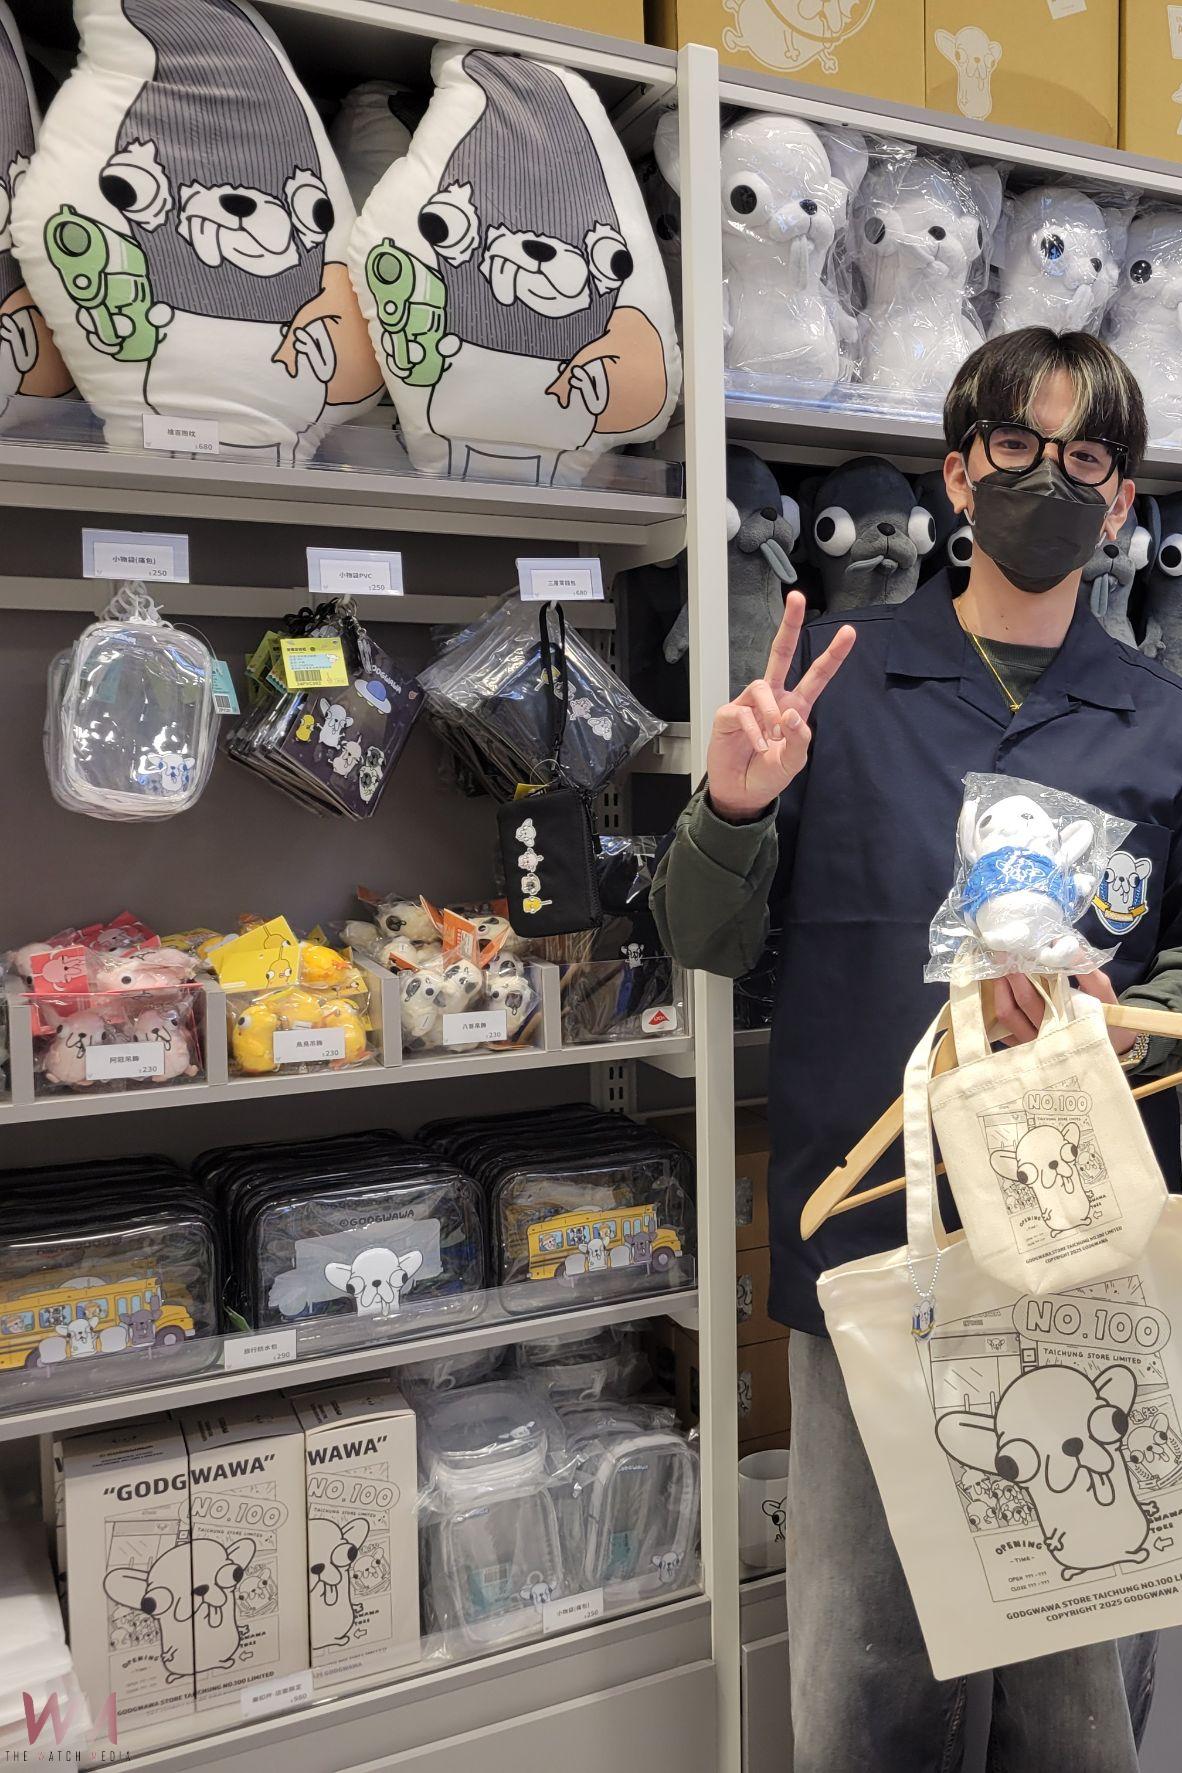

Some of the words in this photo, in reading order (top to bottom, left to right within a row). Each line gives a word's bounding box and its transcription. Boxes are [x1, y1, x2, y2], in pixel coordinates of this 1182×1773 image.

[1027, 1093, 1088, 1112] NO.100
[1026, 1300, 1160, 1347] NO.100
[1043, 1347, 1084, 1358] TAICHUNG
[1087, 1352, 1110, 1361] STORE
[1113, 1355, 1142, 1365] LIMITED
[995, 1540, 1043, 1555] OPENING
[1006, 1602, 1061, 1620] GODGWAWA
[1062, 1594, 1091, 1608] STORE
[1092, 1584, 1140, 1600] TAICHUNG
[1140, 1576, 1174, 1590] NO.100
[1046, 1604, 1097, 1622] COPYRIGHT
[1099, 1598, 1123, 1610] 2025
[1123, 1586, 1179, 1605] GODGWAWA
